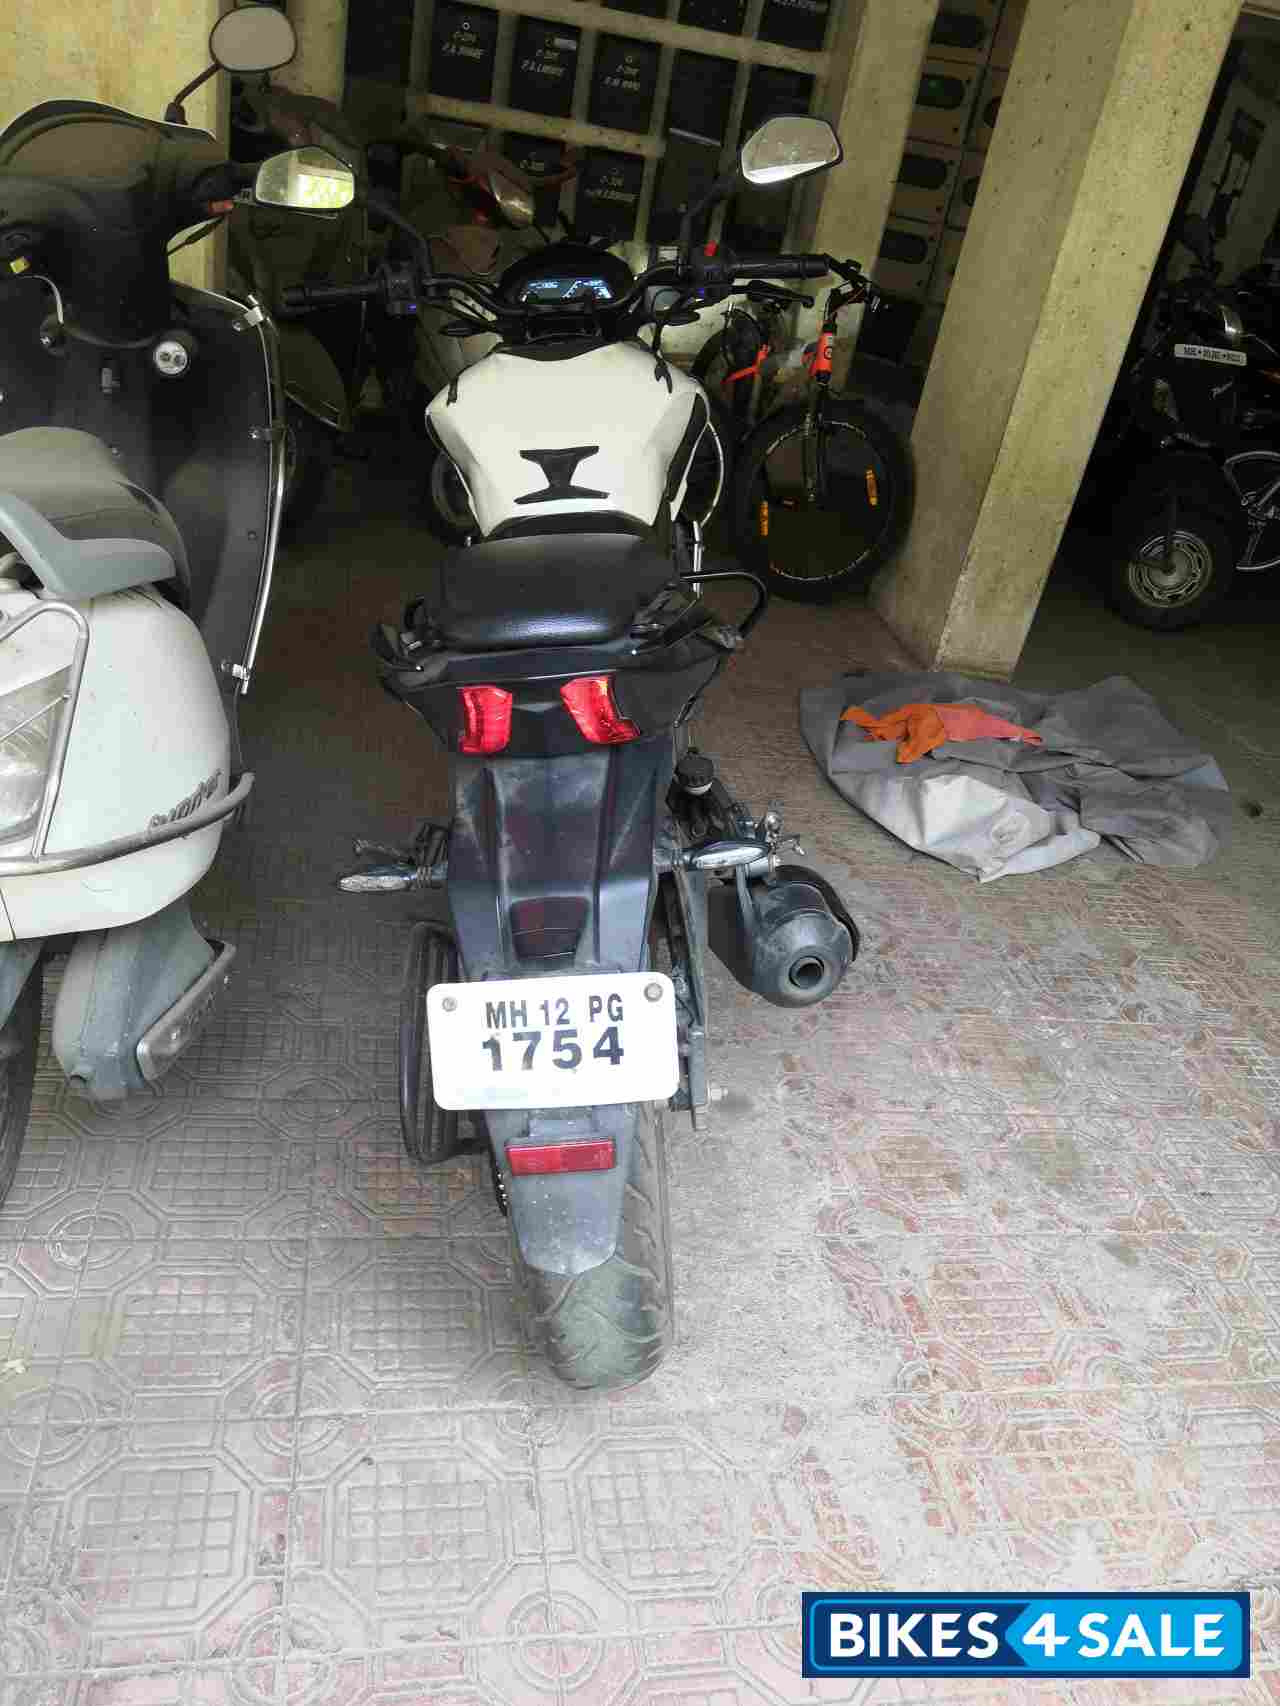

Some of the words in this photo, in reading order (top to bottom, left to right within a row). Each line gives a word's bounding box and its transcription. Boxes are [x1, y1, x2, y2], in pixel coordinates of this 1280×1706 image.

[485, 1000, 528, 1029] MH
[539, 998, 571, 1026] 12
[588, 993, 624, 1023] PG
[482, 1026, 624, 1072] 1754
